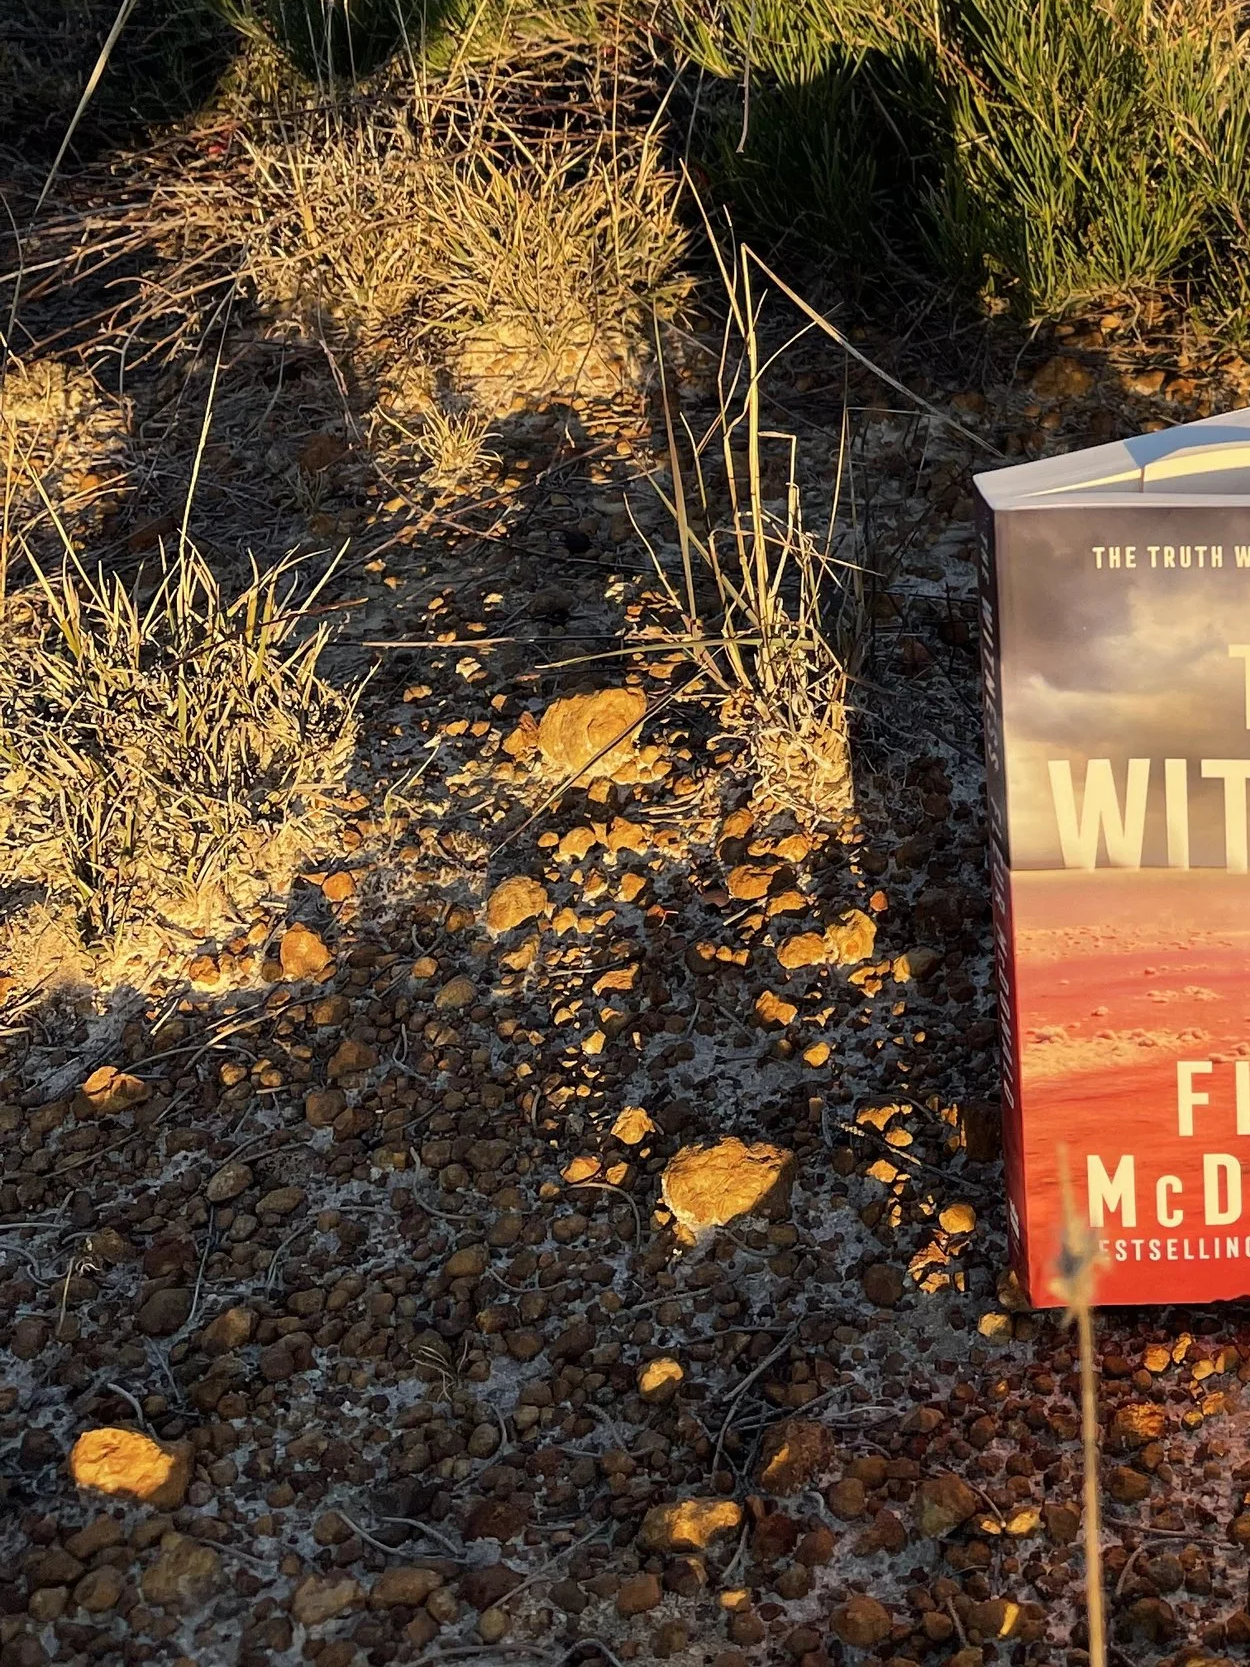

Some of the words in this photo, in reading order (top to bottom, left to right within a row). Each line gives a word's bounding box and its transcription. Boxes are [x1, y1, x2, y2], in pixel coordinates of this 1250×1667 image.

[1092, 546, 1136, 569] THE
[1147, 545, 1223, 568] TRUTH
[981, 596, 999, 772] WITNESS
[991, 797, 1005, 916] FLEUR
